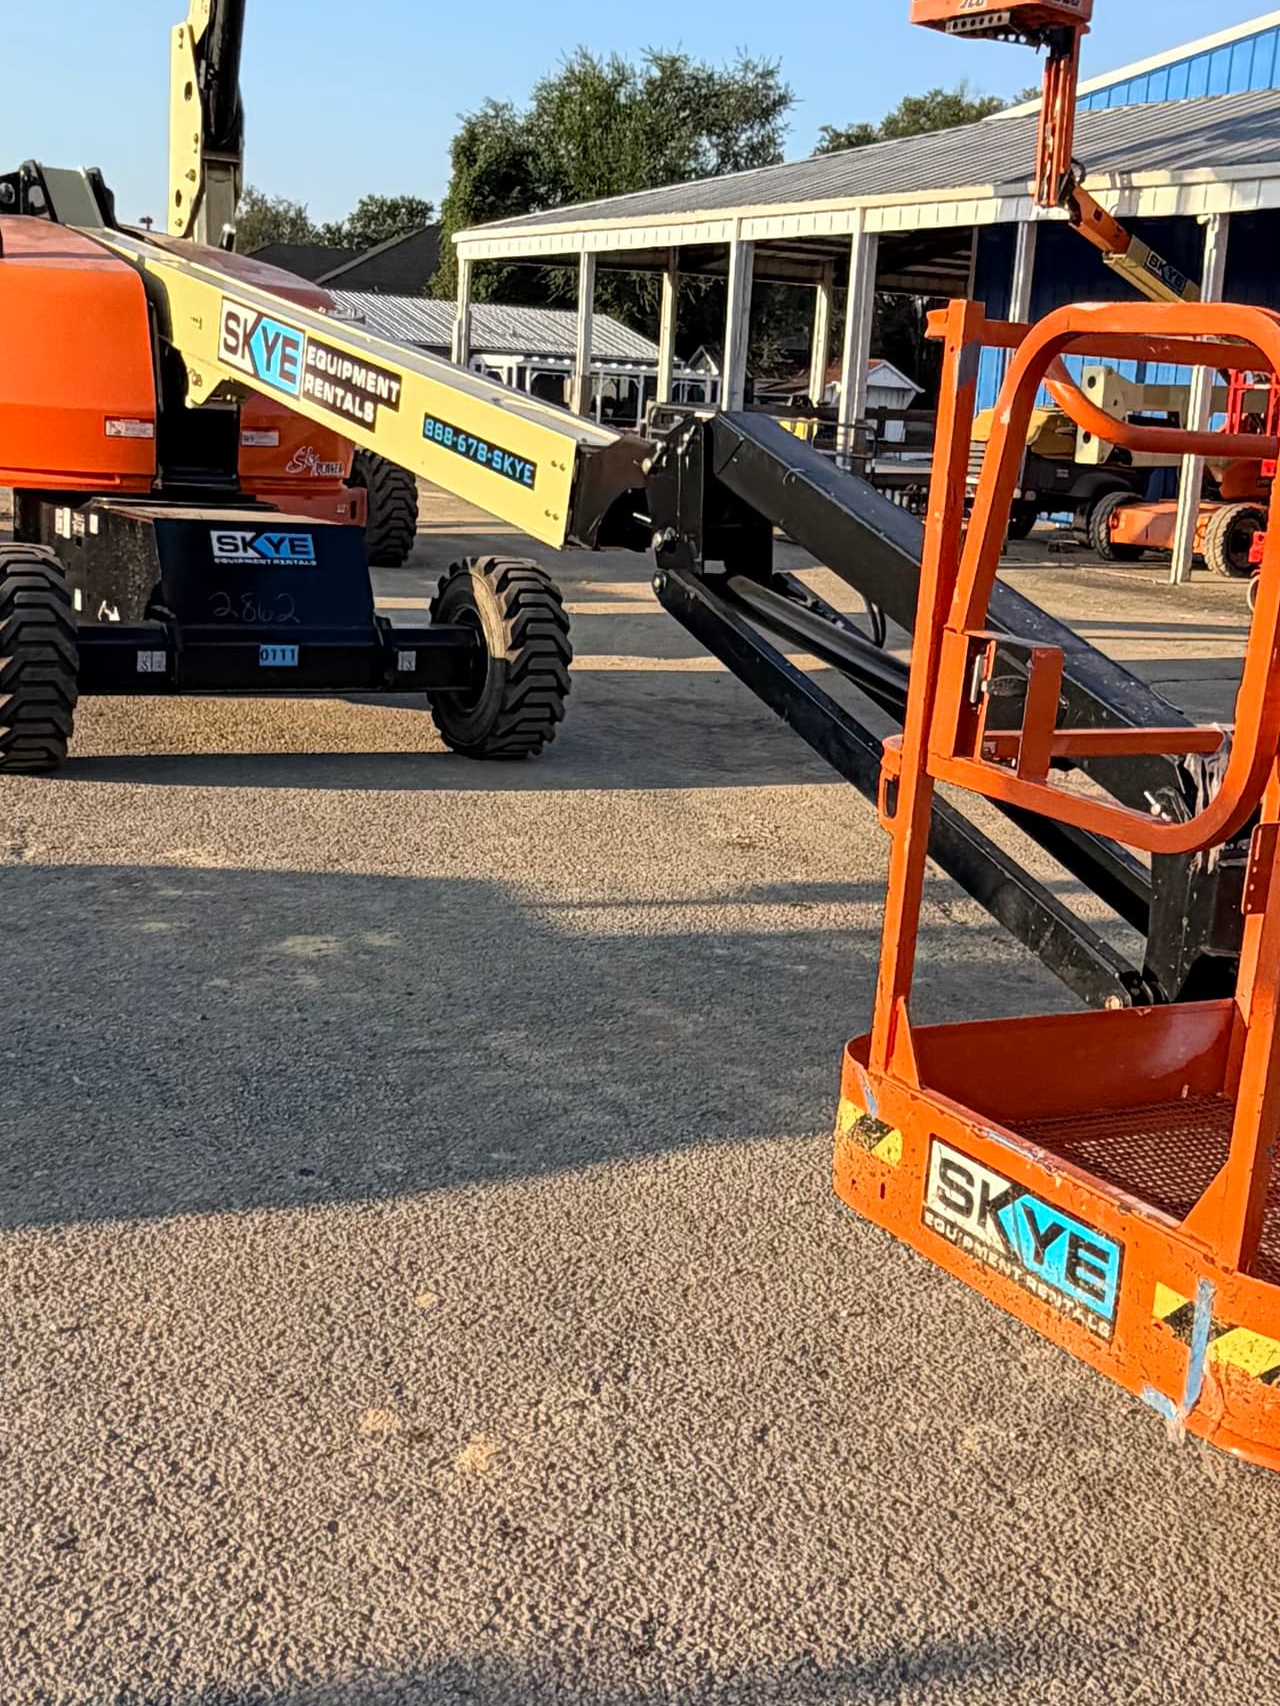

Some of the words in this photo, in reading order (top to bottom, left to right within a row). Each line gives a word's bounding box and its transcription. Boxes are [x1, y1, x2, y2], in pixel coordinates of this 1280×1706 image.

[223, 309, 300, 384] SKYE
[303, 372, 375, 423] RENTALS
[306, 346, 401, 404] EQUIPMENT
[216, 533, 312, 557] SKYE
[209, 592, 301, 623] 2862
[259, 646, 297, 662] 0111
[936, 1156, 1111, 1304] SKYE
[924, 1211, 1025, 1280] EQUIPMENT
[1025, 1276, 1111, 1339] RENTALS
